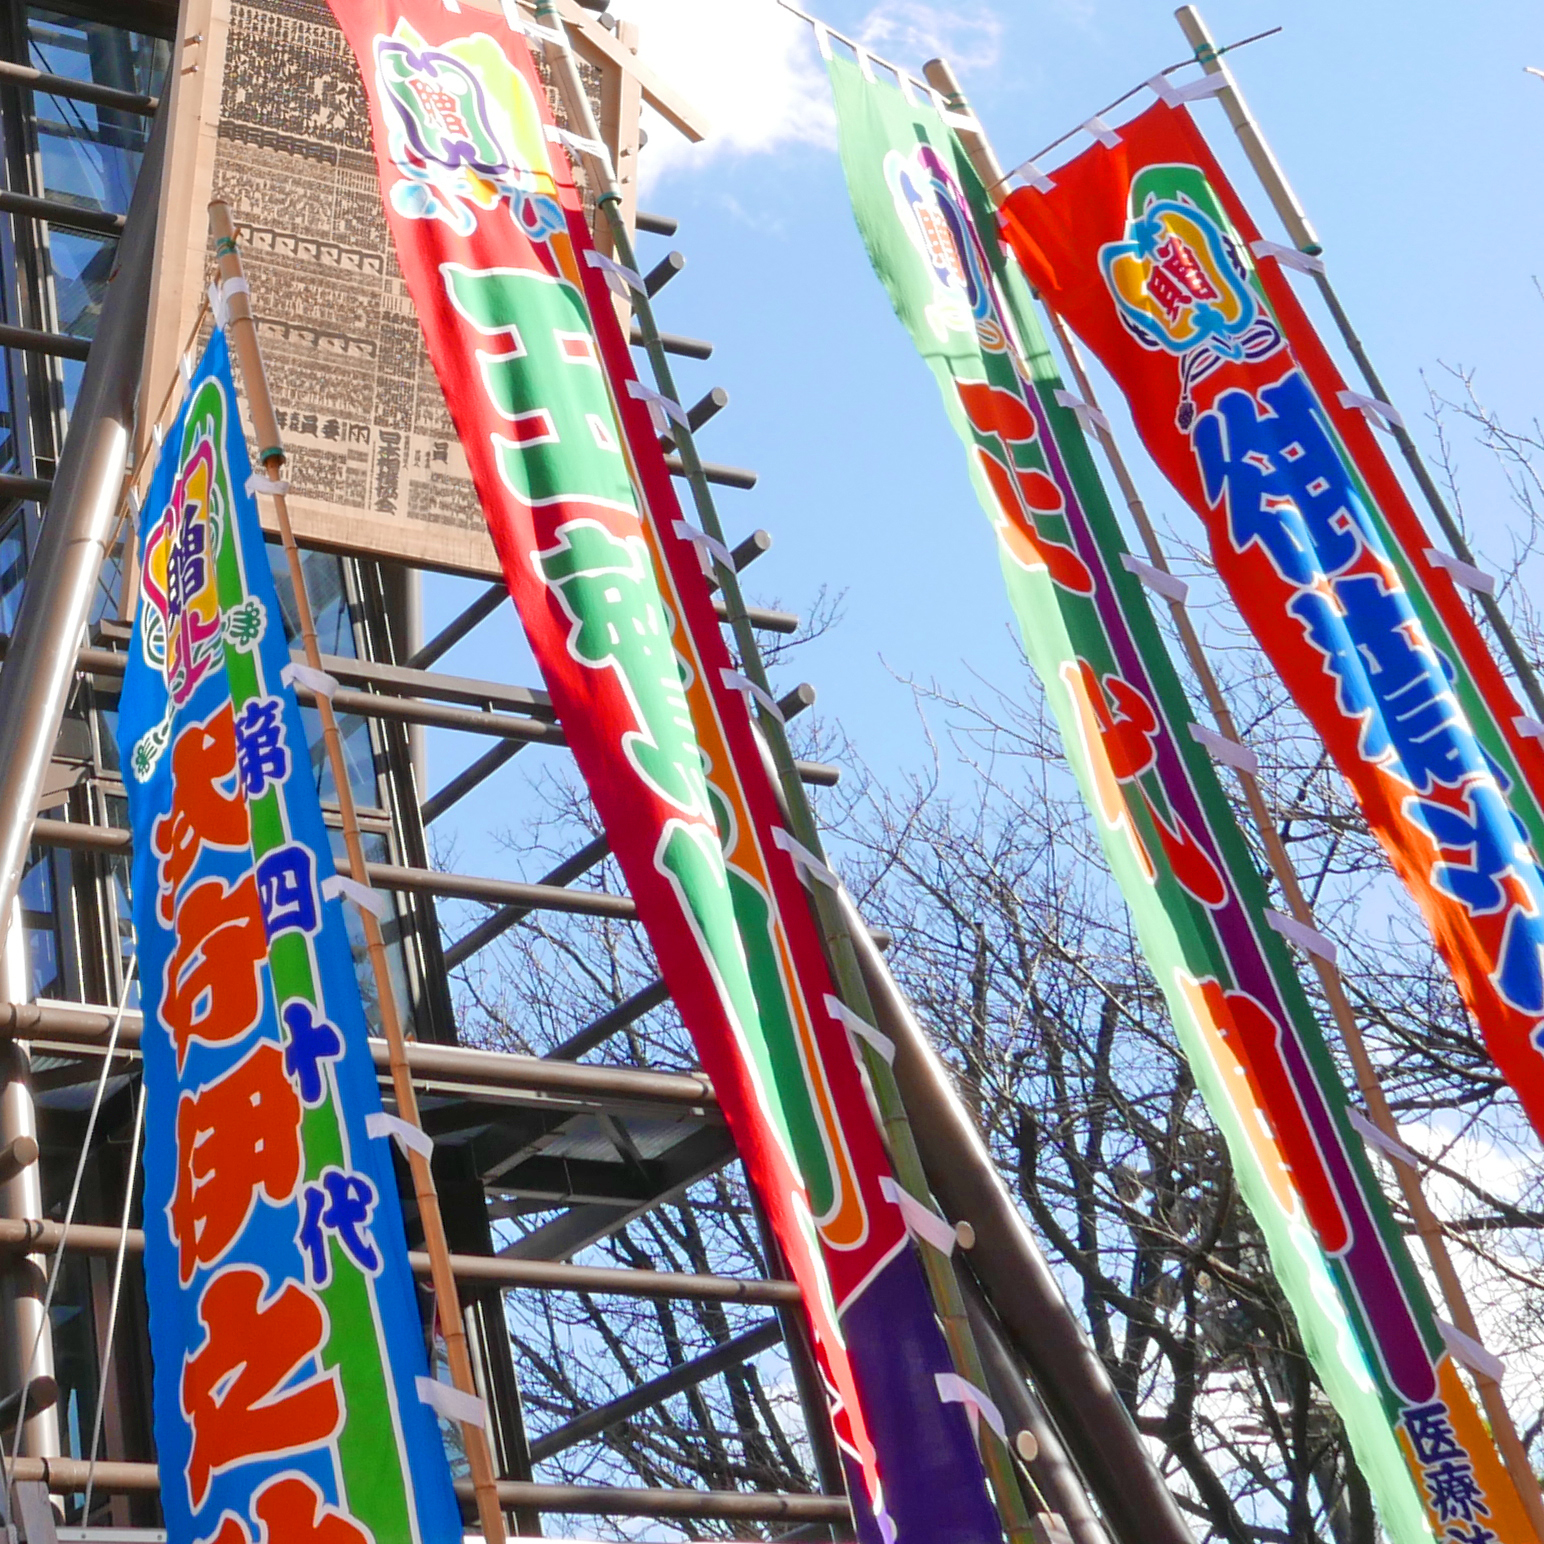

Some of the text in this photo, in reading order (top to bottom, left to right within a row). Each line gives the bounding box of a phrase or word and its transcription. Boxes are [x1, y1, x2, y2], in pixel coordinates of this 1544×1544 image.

[407, 77, 470, 141] 贈
[166, 503, 206, 624] 贈
[234, 696, 383, 1290] 第四十代
[1397, 1401, 1502, 1544] 医療
